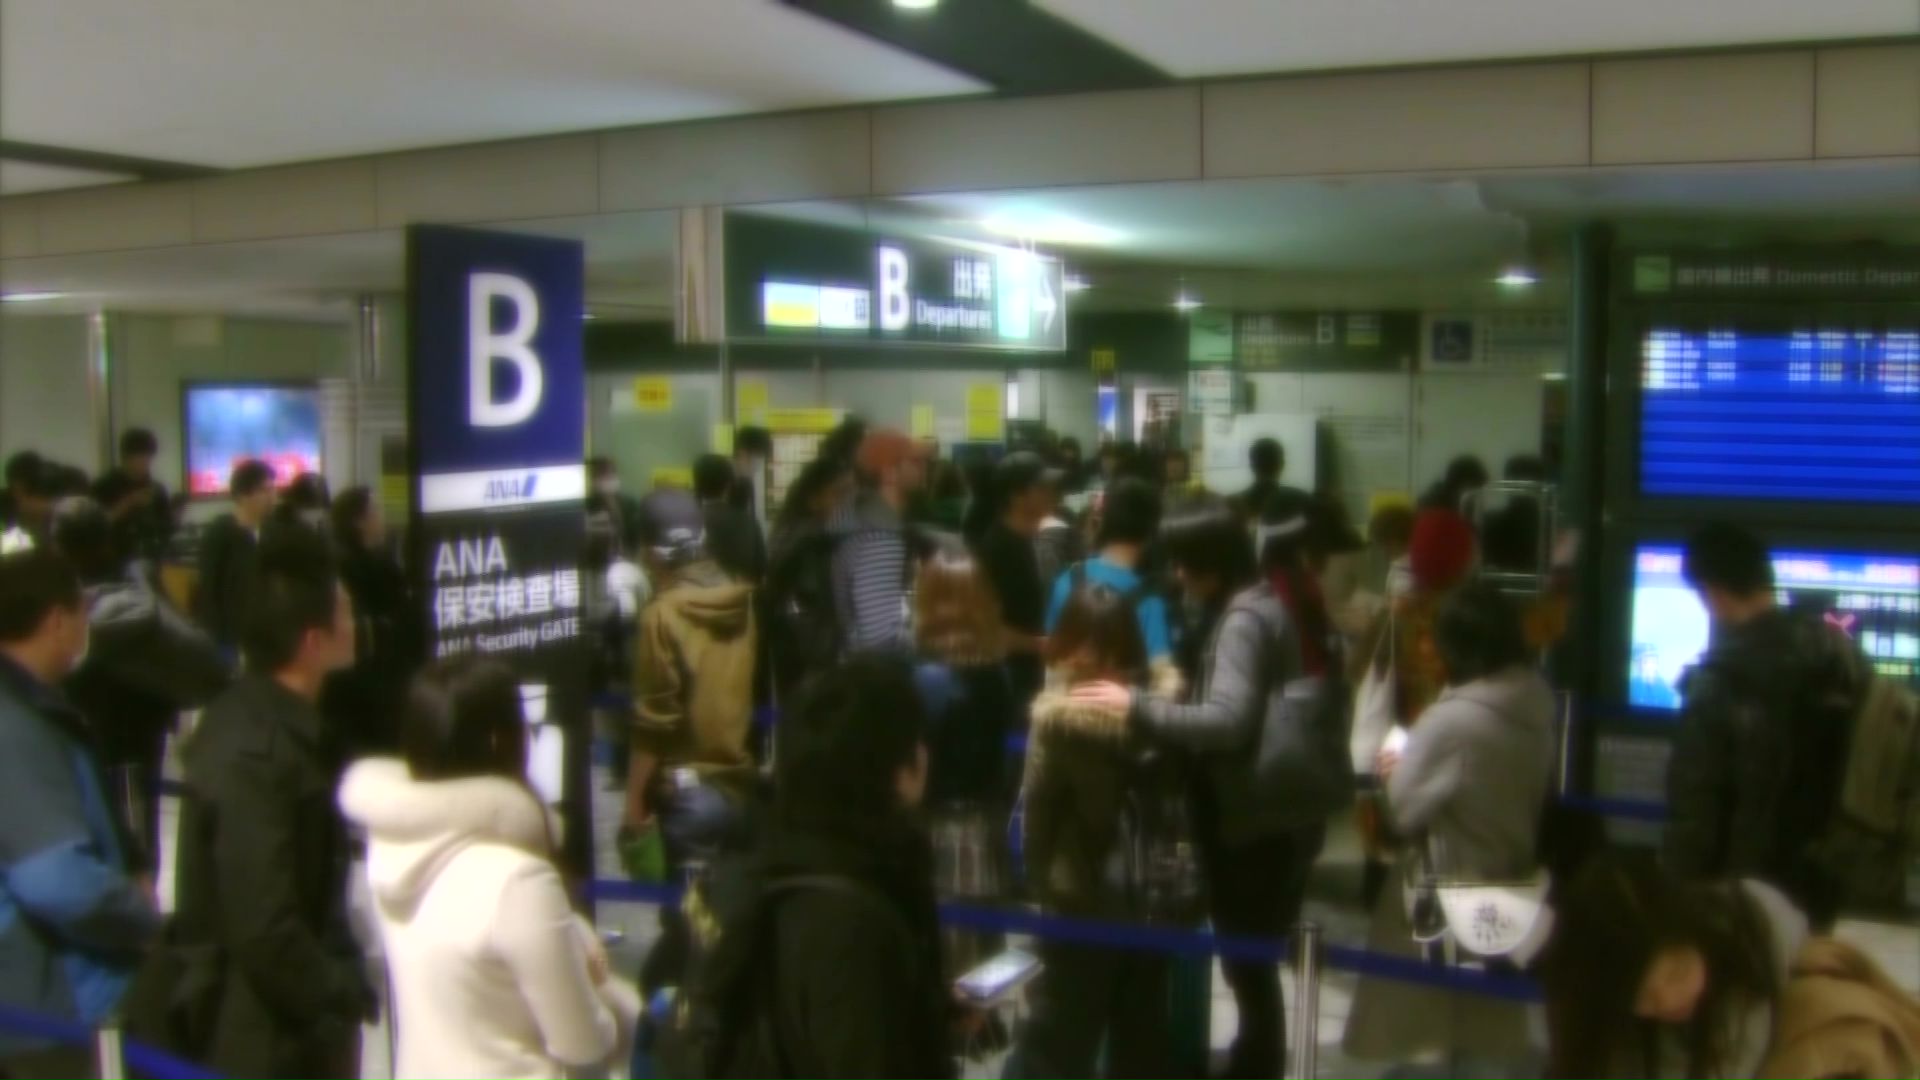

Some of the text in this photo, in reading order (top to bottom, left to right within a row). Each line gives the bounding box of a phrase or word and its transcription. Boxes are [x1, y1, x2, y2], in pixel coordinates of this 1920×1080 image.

[879, 246, 909, 330] B
[469, 273, 543, 427] B
[1316, 315, 1335, 344] B
[484, 480, 519, 500] ANA
[435, 538, 508, 580] ANA
[436, 570, 580, 631] 保安検査場
[476, 627, 535, 651] Security
[543, 617, 580, 642] GATE
